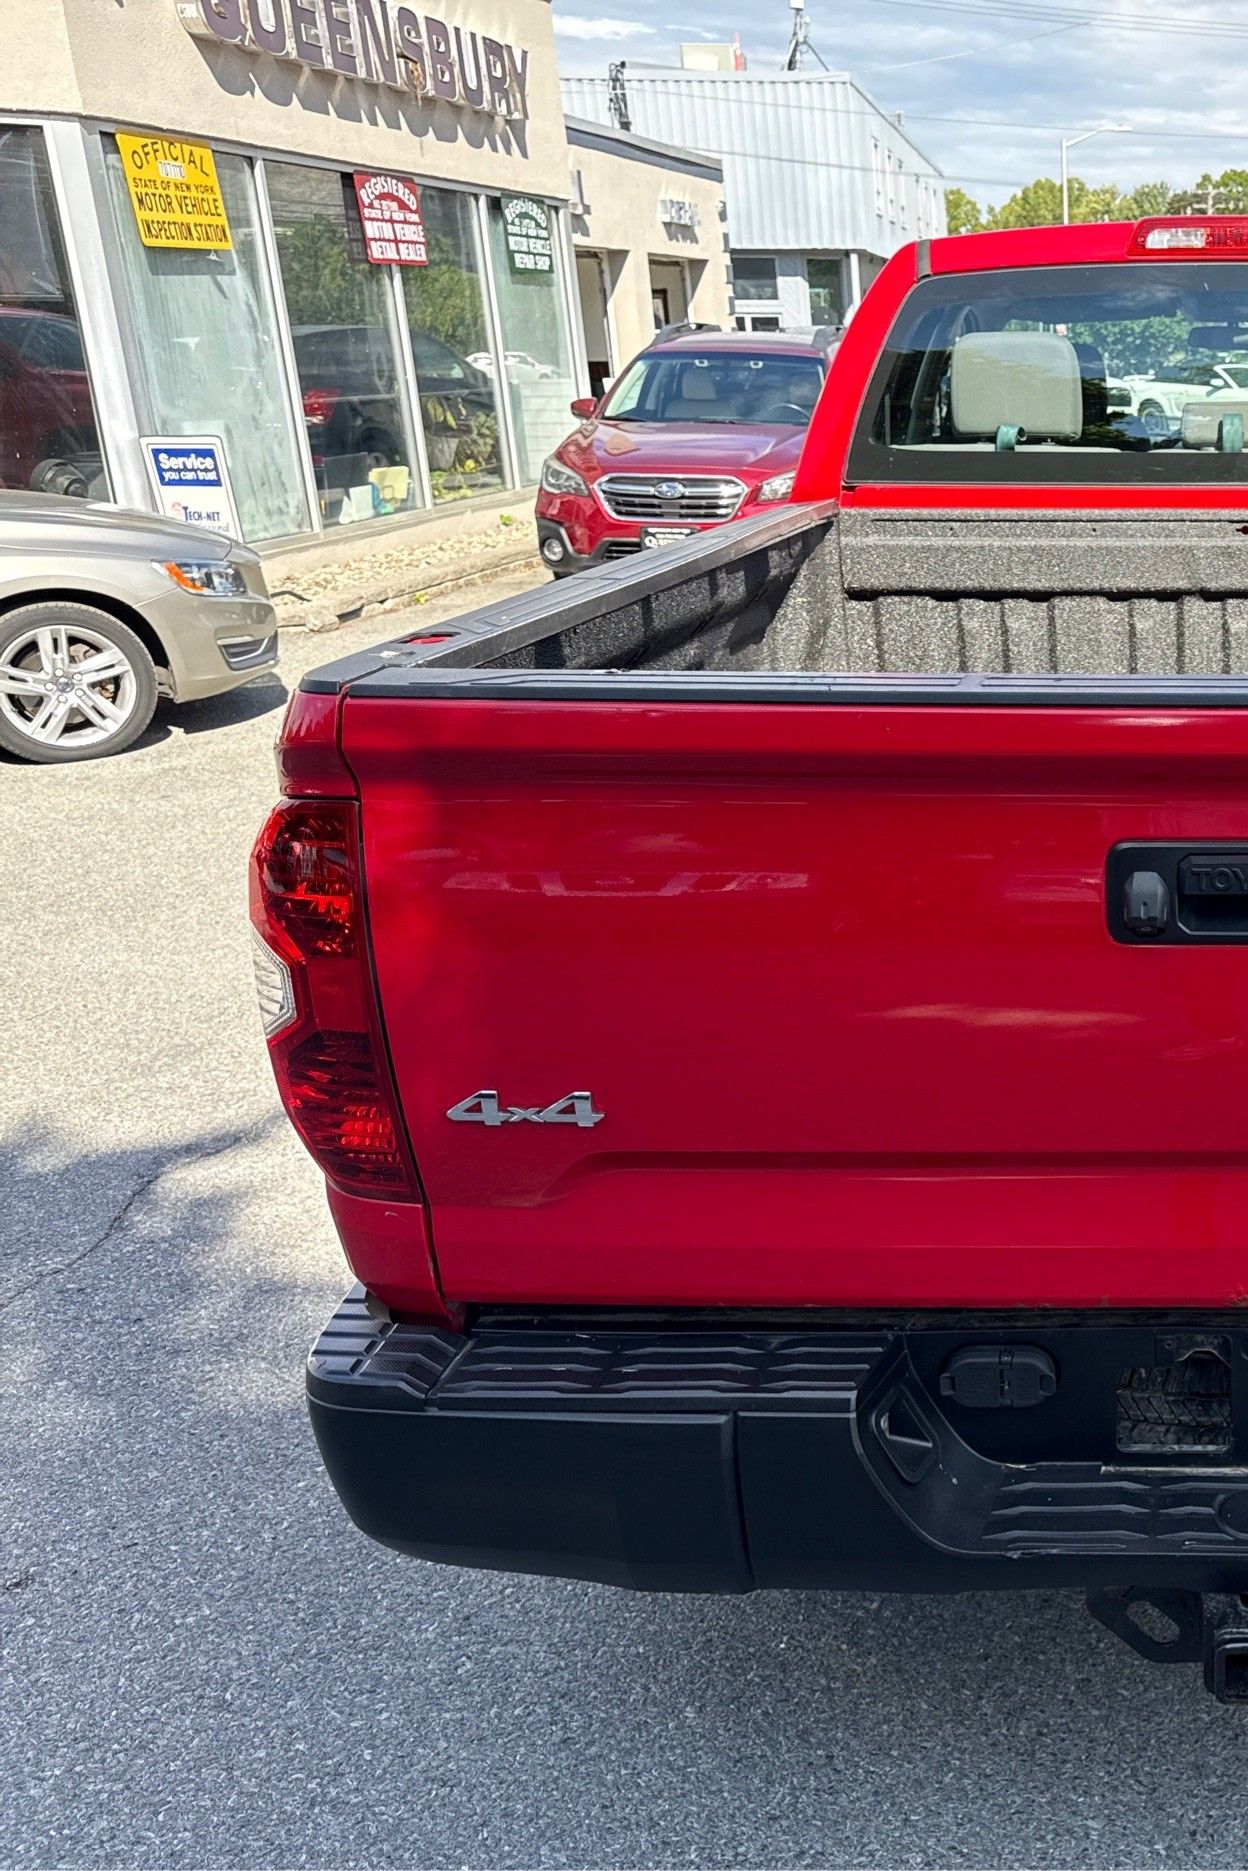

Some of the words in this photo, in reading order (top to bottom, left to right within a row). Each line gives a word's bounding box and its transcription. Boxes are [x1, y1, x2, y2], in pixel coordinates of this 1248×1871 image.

[131, 140, 209, 177] OFFICIAL
[133, 177, 159, 190] STATE
[161, 178, 171, 191] OF
[175, 182, 191, 193] NEW
[194, 184, 216, 195] YORK
[360, 176, 417, 210] REGISTERED
[135, 191, 175, 214] MOTOR
[175, 194, 222, 217] VEHICLE
[504, 198, 547, 228] REGISTERED
[141, 219, 194, 241] INSPECTION
[194, 222, 229, 243] STATION
[364, 221, 396, 239] MOTOR
[393, 223, 425, 242] VEHICLE
[370, 240, 400, 260] RETAIL
[398, 243, 427, 261] DEALER
[158, 453, 214, 469] Service
[162, 471, 179, 482] you
[180, 471, 196, 480] can
[197, 470, 217, 480] trust
[447, 1090, 604, 1127] 4x4
